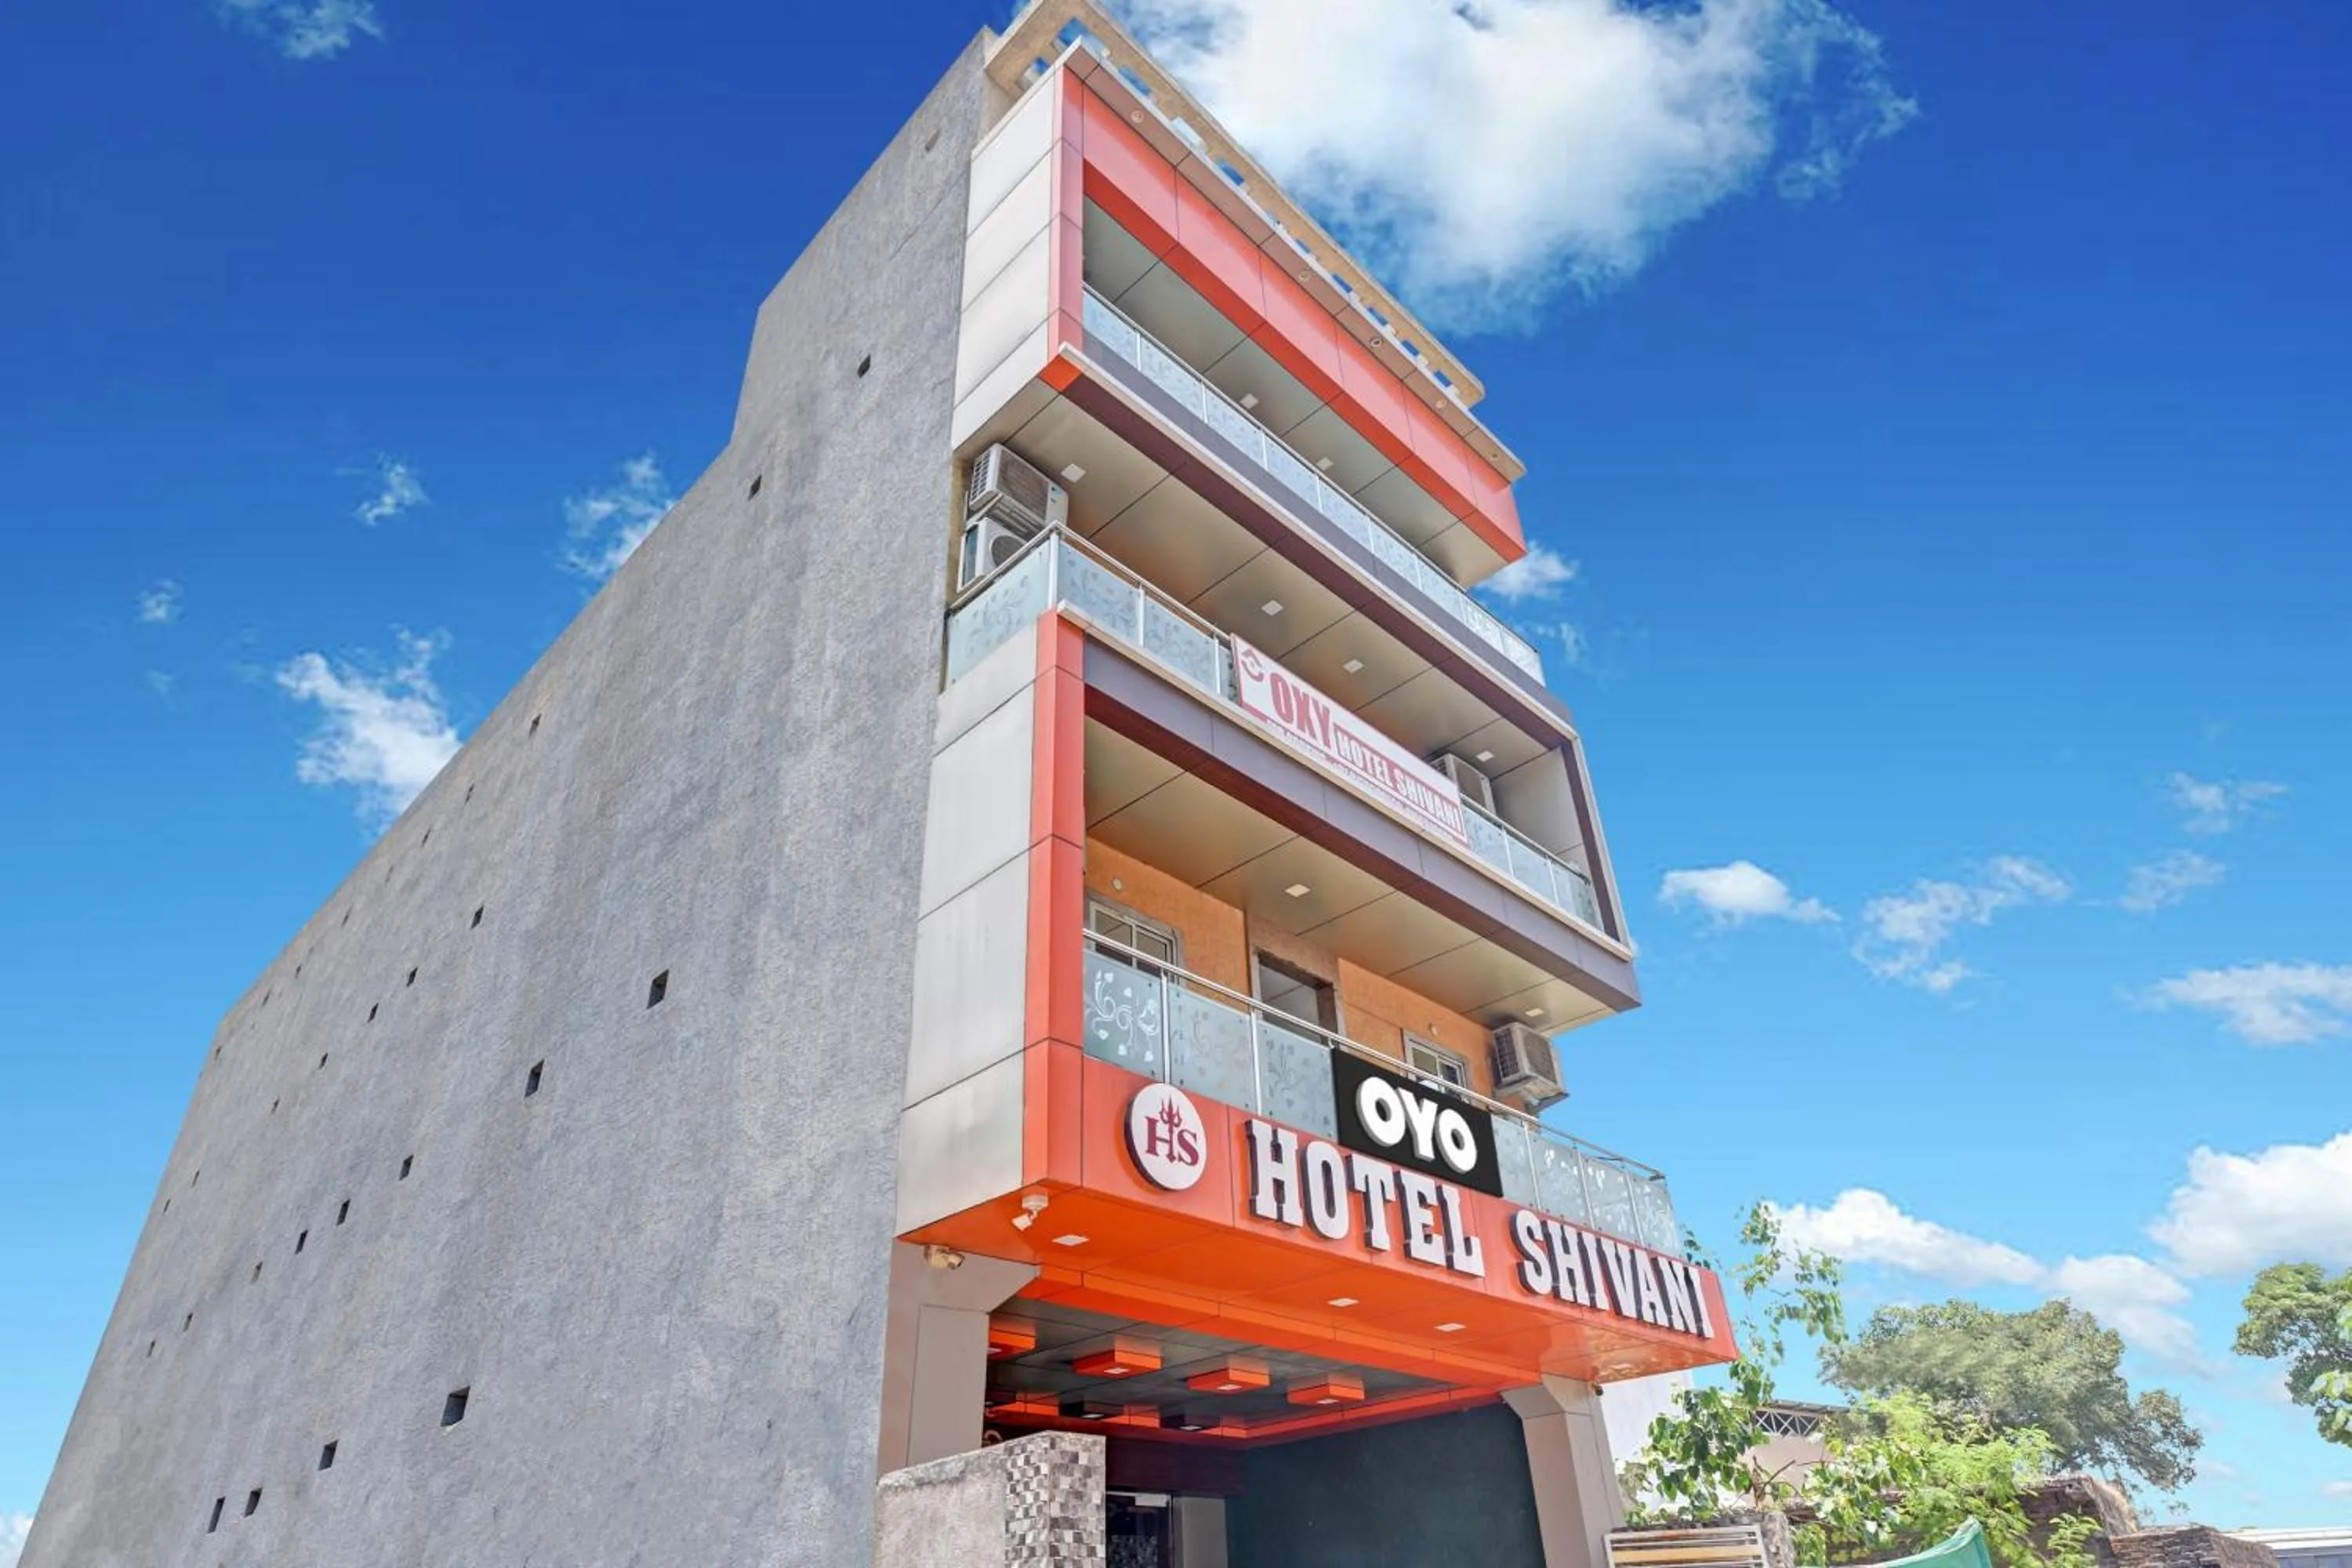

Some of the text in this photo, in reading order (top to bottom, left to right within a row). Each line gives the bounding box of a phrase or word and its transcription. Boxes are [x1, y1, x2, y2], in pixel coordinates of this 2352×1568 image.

[1270, 672, 1331, 750] OXY
[1335, 729, 1392, 789] HOTEL
[1393, 768, 1464, 837] SHIVANI
[1145, 1116, 1200, 1167] HS
[1356, 1076, 1478, 1174] OYO
[1247, 1119, 1715, 1339] HOTEL SHIVANI
